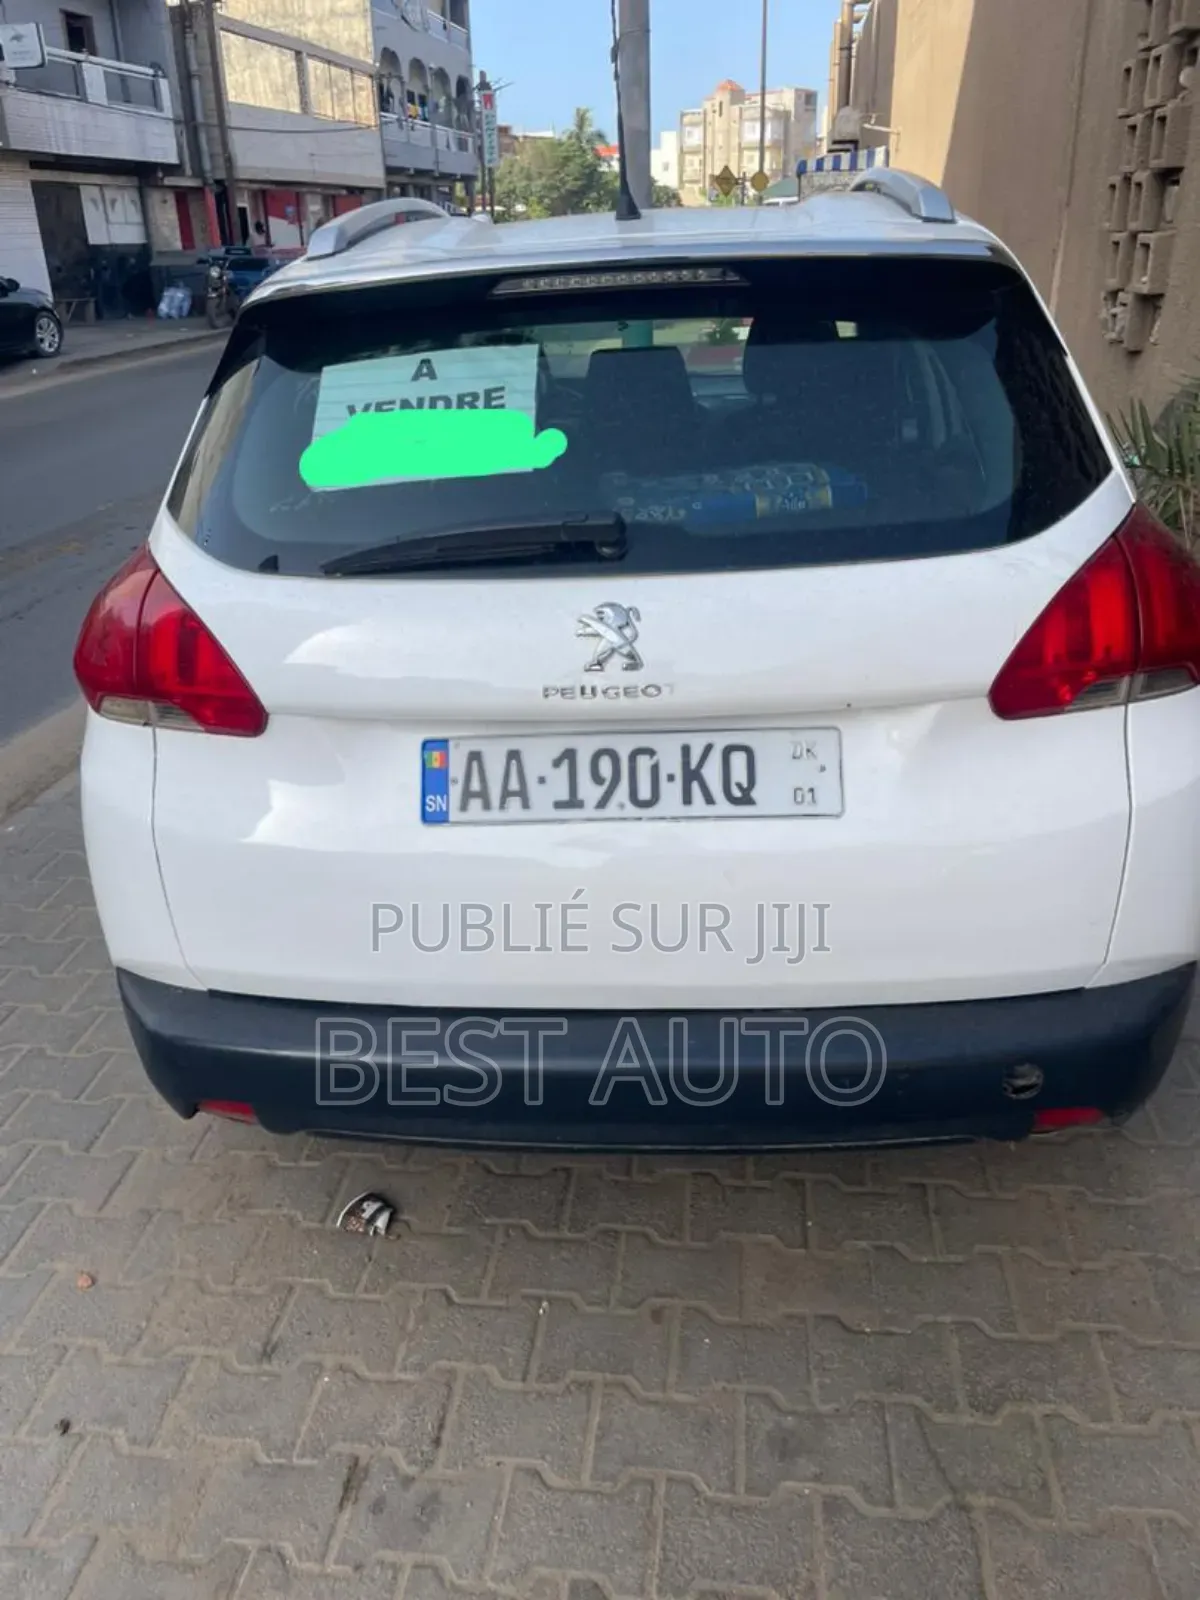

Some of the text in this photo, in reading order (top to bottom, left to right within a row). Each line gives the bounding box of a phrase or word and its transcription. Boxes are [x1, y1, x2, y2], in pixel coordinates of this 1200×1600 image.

[411, 358, 438, 381] A
[542, 683, 675, 700] PEUGEOT
[425, 795, 447, 812] SN
